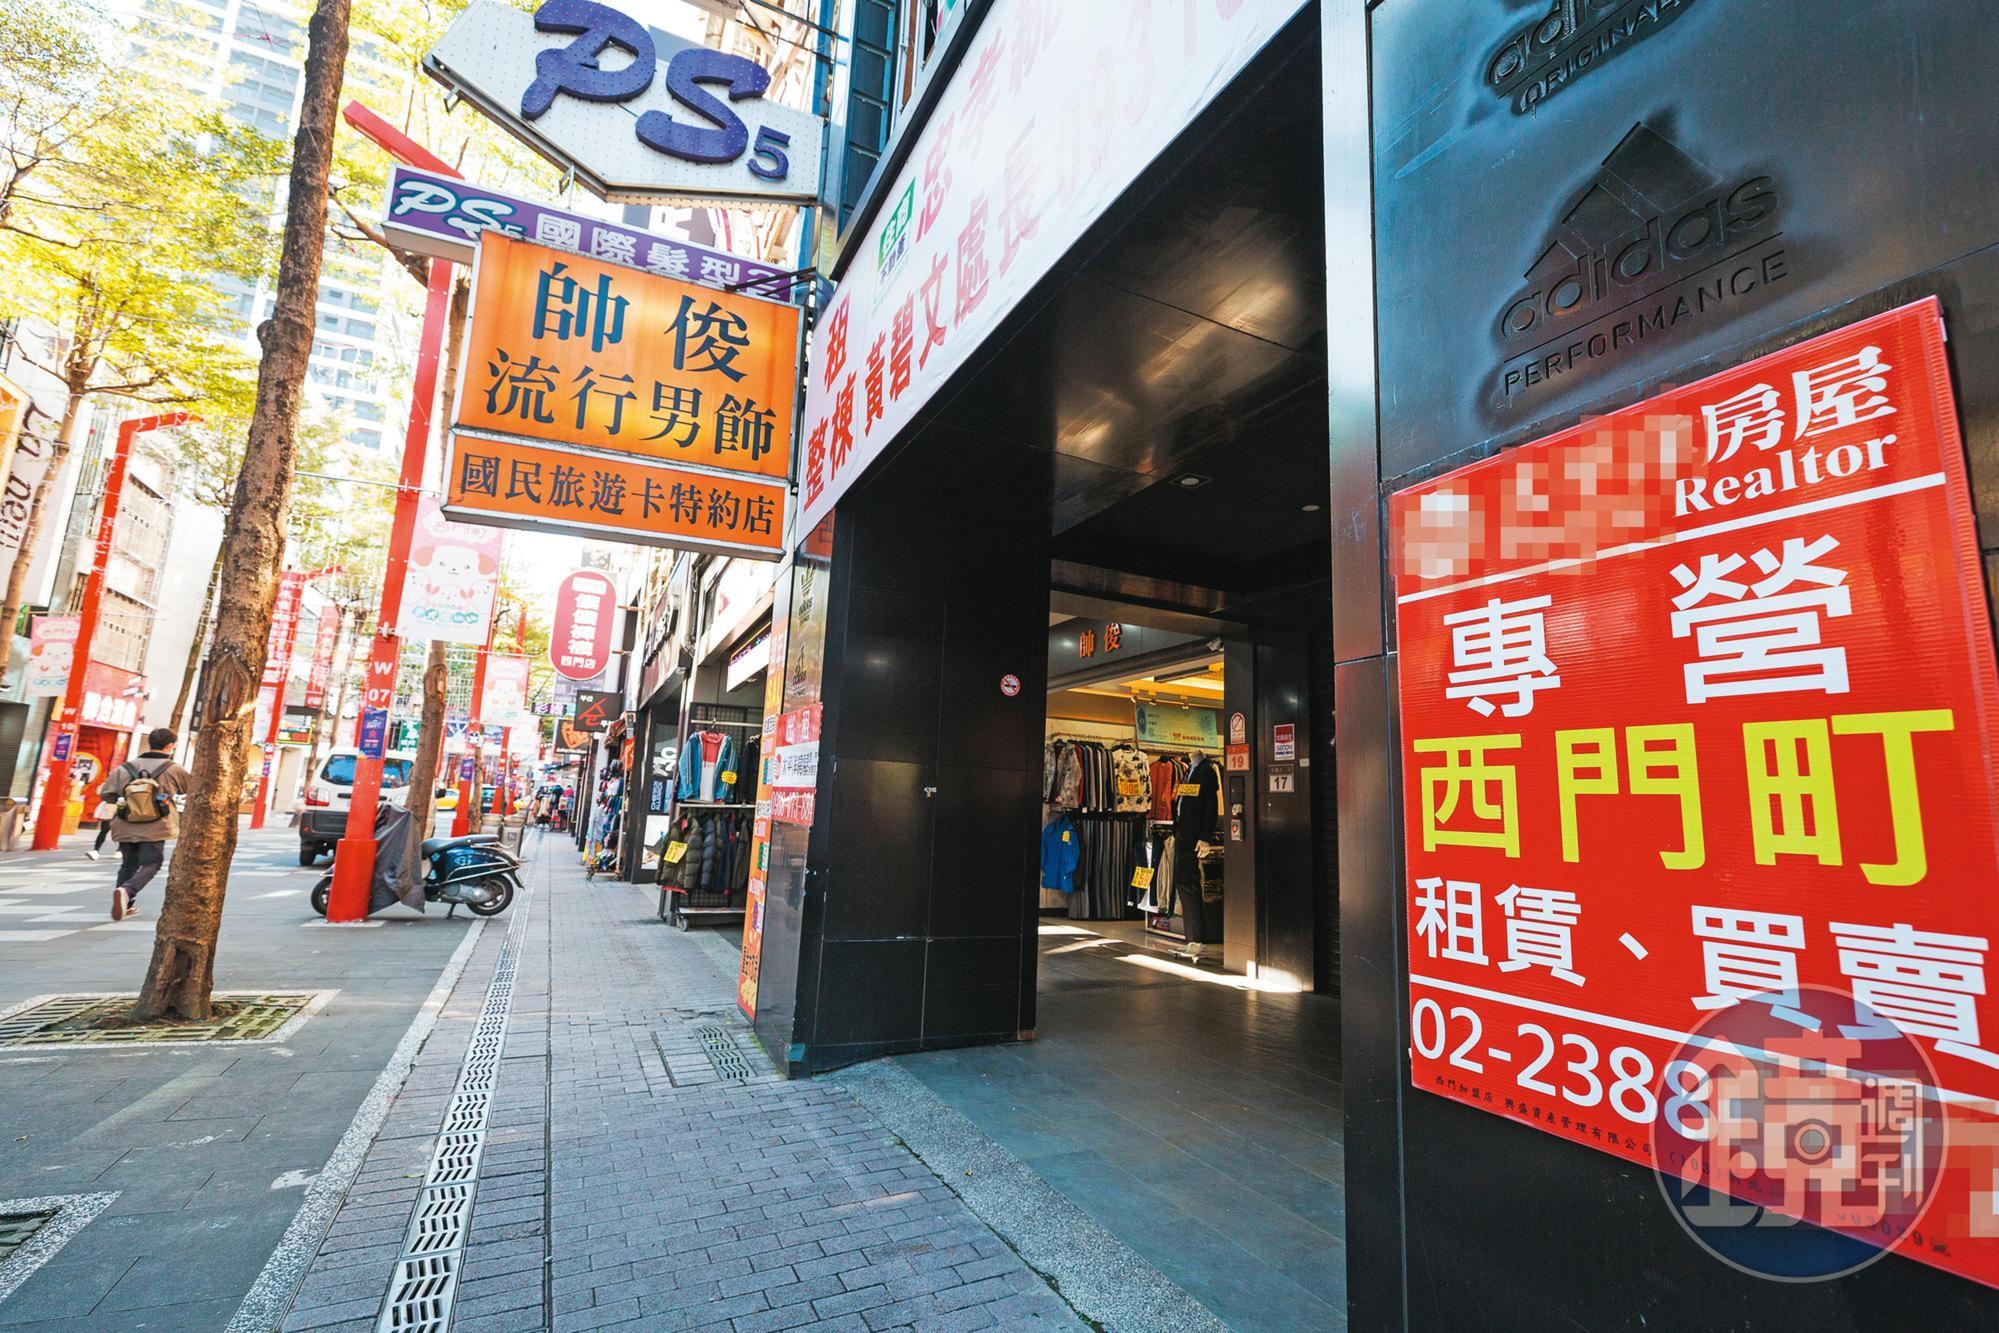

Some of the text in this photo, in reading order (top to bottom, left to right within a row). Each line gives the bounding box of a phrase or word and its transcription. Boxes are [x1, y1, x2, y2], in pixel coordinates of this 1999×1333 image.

[1500, 175, 1781, 345] adidas
[824, 287, 851, 394] 租
[1503, 249, 1789, 397] PERFORMANCE
[484, 347, 777, 462] 流行男飾
[803, 370, 858, 513] 整棟
[1700, 345, 1899, 469] 房屋
[460, 452, 775, 536] 國民旅遊卡特約店
[1672, 432, 1899, 521] Realtor
[368, 688, 391, 702] 07
[374, 661, 393, 675] W
[561, 655, 596, 669] 西門店
[1231, 755, 1244, 768] 19
[1274, 776, 1288, 790] 17
[1413, 709, 1956, 888] 西門町
[1415, 876, 1999, 1071] 租賃、買賣
[1435, 1074, 1494, 1104] 西門加盟店
